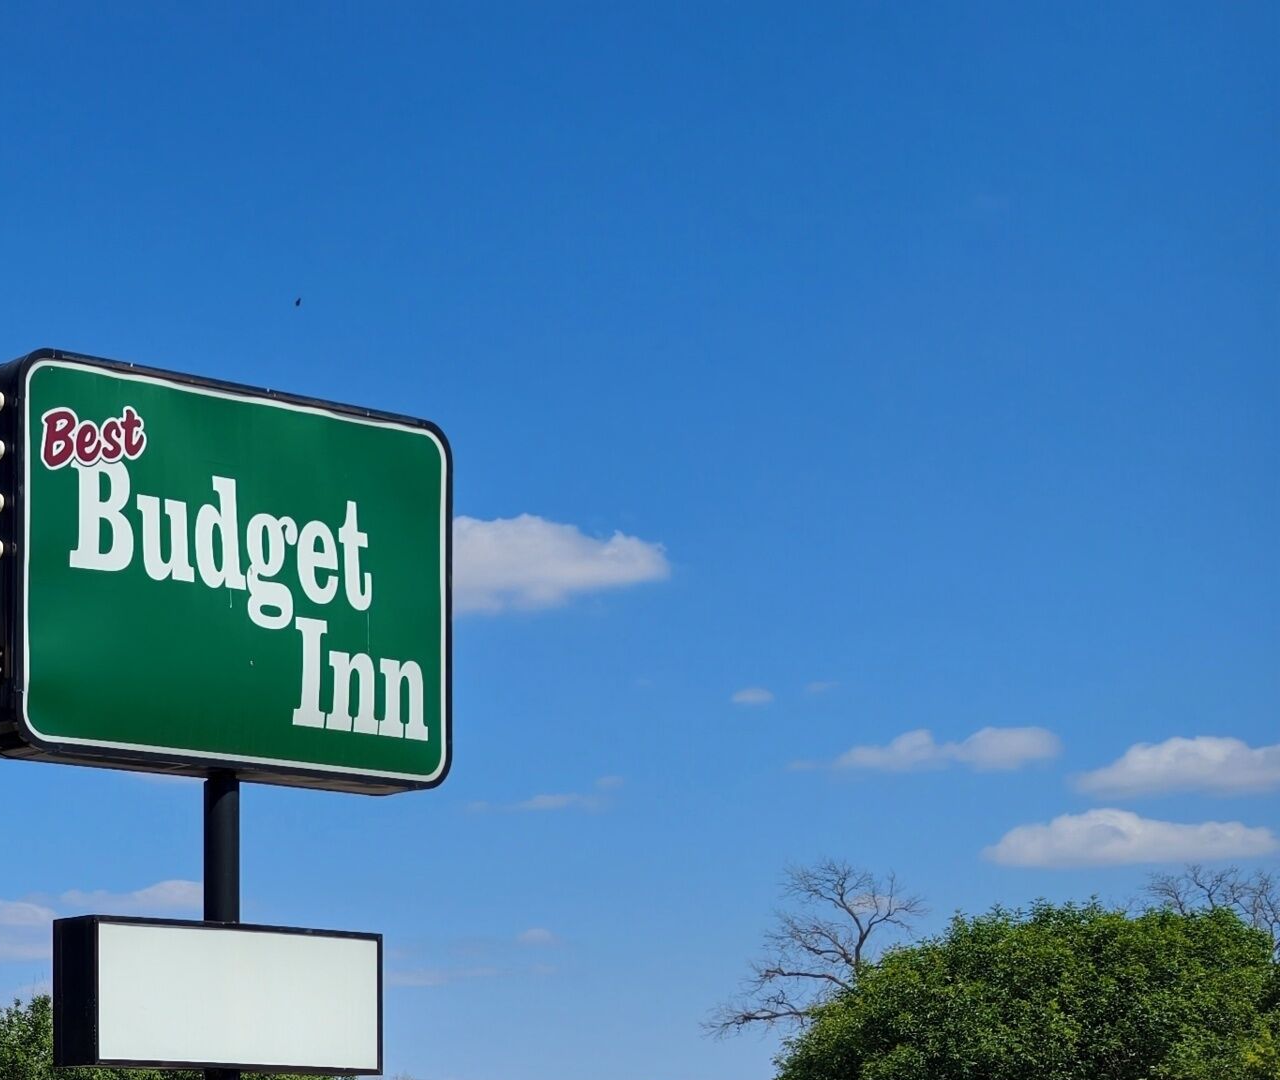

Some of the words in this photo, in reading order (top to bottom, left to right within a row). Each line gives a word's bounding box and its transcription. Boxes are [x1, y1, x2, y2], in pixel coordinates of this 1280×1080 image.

[42, 406, 147, 470] Best
[69, 460, 372, 629] Budget
[293, 616, 429, 741] Inn
